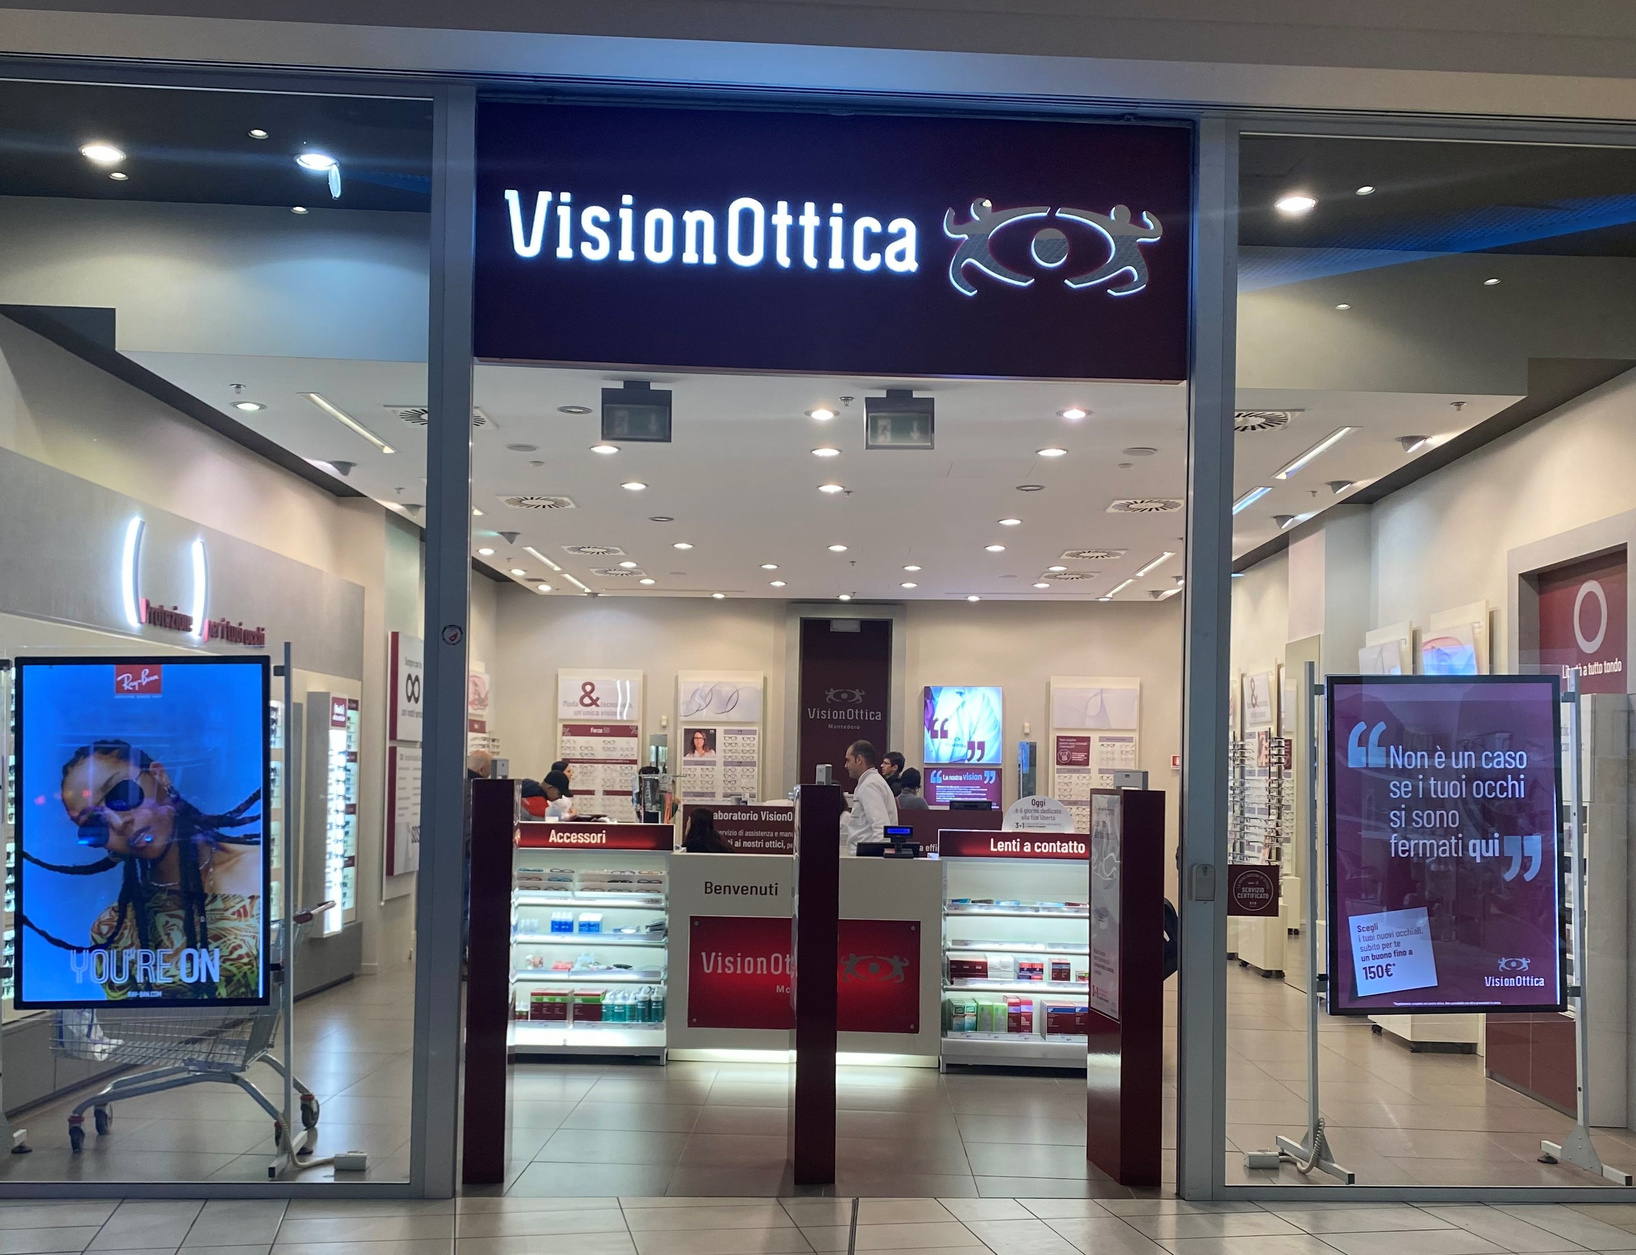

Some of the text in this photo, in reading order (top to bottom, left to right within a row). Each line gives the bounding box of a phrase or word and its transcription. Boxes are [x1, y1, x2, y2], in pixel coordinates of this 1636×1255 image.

[503, 187, 919, 273] VisionOttica
[1583, 664, 1588, 676] a
[1588, 661, 1603, 676] tutto
[1604, 657, 1622, 673] tondo
[117, 668, 159, 691] Ray-Ban
[807, 707, 882, 720] VisionOttica
[1389, 744, 1528, 769] Non è un caso
[963, 772, 983, 781] vision
[1389, 774, 1525, 798] se i tuoi occhi
[1031, 799, 1046, 808] Oggi
[713, 810, 793, 822] aboratorio VisionO
[1389, 804, 1460, 828] si sono
[548, 829, 606, 843] Accessori
[718, 829, 737, 837] ervizio
[742, 839, 764, 848] nostri
[765, 840, 786, 849] ottici,
[925, 844, 938, 852] effi
[990, 837, 1086, 854] Lenti a contatto
[1389, 832, 1500, 863] fermati qui
[704, 881, 779, 896] Benvenuti
[1357, 923, 1379, 933] Scegli
[1362, 933, 1376, 942] tuoi
[1376, 931, 1394, 940] nuovi
[1359, 940, 1401, 953] subito per te
[1371, 951, 1392, 961] buono
[1393, 949, 1407, 957] fino
[180, 947, 220, 983] ON
[701, 951, 792, 975] VisionOt
[1484, 975, 1545, 987] VisionOttica
[776, 985, 791, 994] Mo
